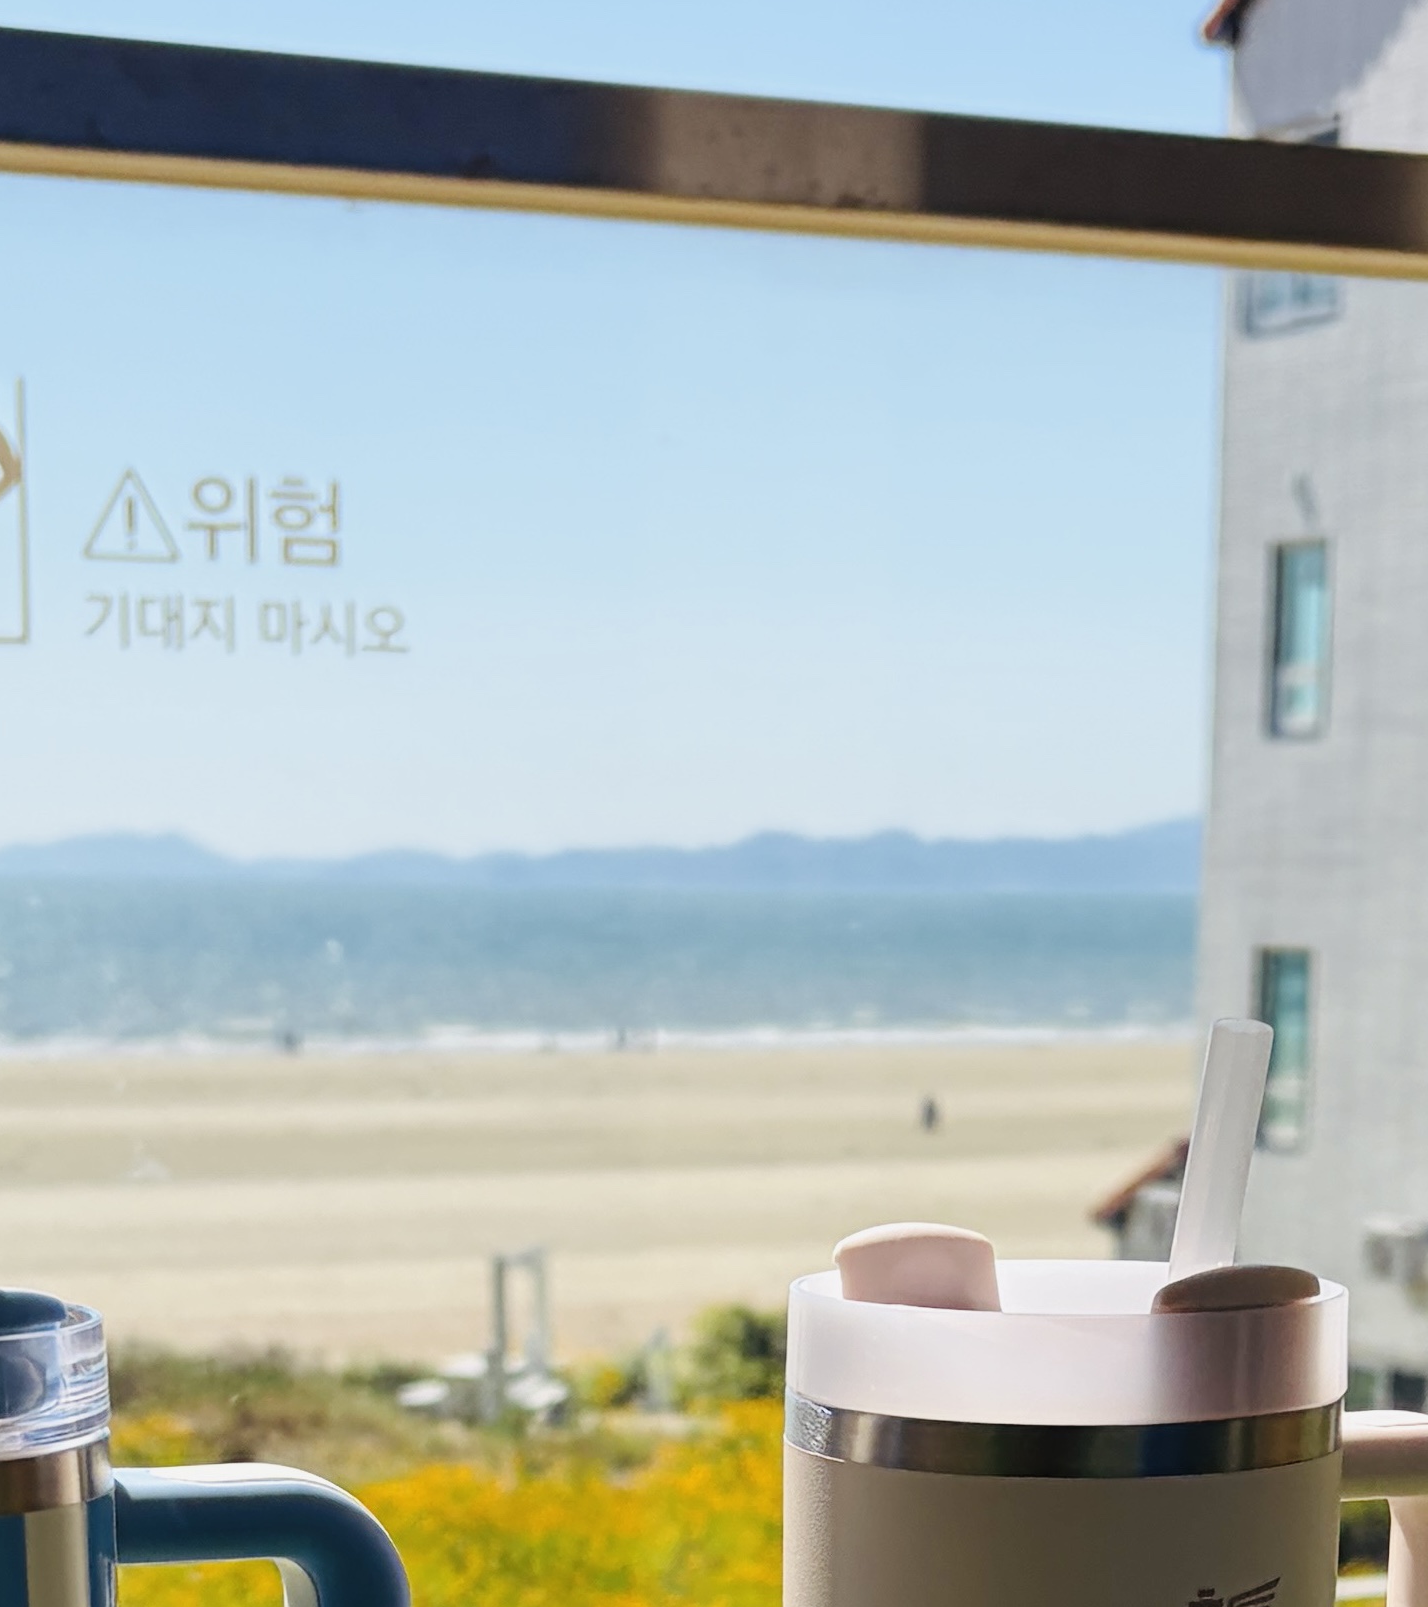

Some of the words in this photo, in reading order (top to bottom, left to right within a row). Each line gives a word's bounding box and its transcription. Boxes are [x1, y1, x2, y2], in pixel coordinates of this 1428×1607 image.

[185, 476, 340, 566] 위험
[85, 592, 235, 651] 기대지
[259, 598, 410, 656] 마시오
